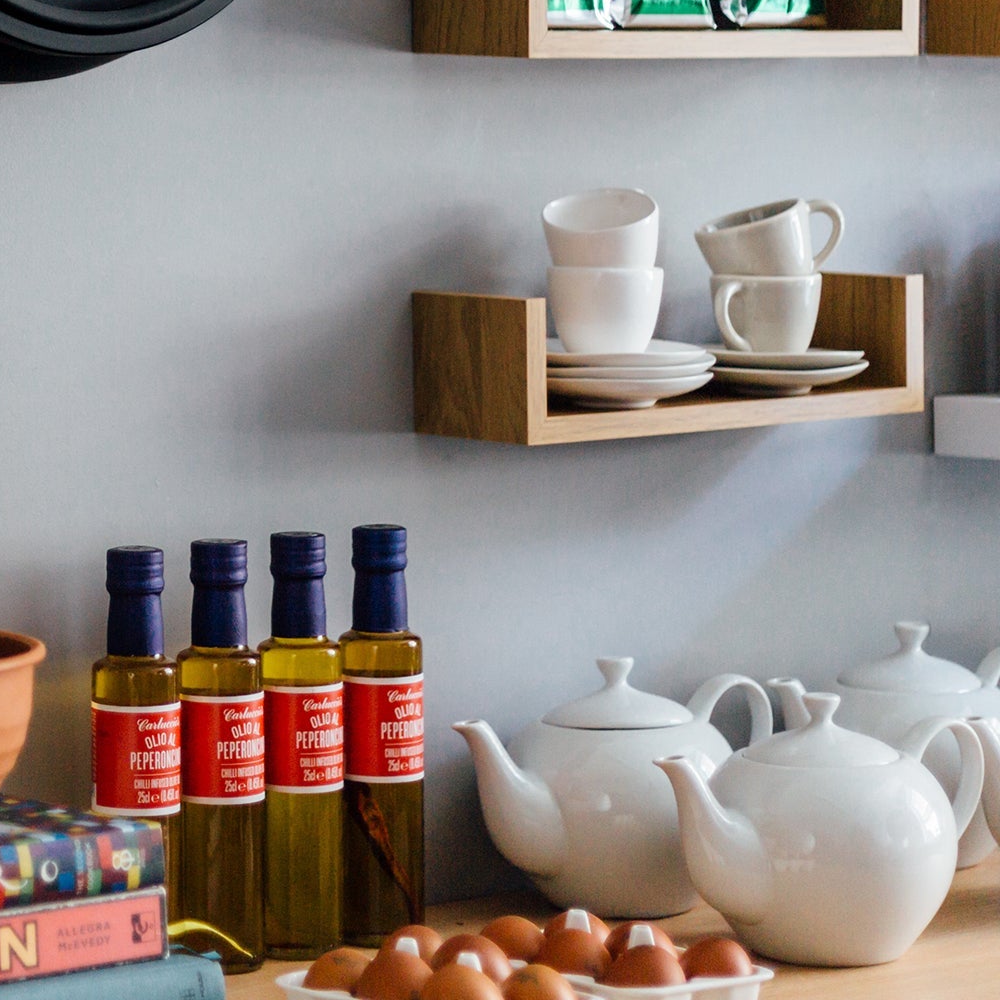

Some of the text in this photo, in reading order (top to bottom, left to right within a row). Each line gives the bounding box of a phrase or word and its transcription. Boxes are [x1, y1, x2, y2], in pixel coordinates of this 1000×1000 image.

[394, 703, 415, 719] OLIO
[310, 712, 339, 728] OLIO AL
[231, 722, 261, 739] OLIO AL
[145, 733, 177, 749] OLIO AL
[388, 759, 400, 772] 25cl
[400, 762, 409, 771] e
[221, 768, 237, 778] CHILLI
[304, 769, 316, 781] 25cl
[316, 772, 325, 781] e
[134, 779, 150, 789] CHILLI
[225, 780, 237, 792] 25cl
[238, 782, 246, 792] e
[138, 791, 150, 804] 25cl
[151, 794, 160, 803] e
[56, 921, 111, 937] ALLEGRA
